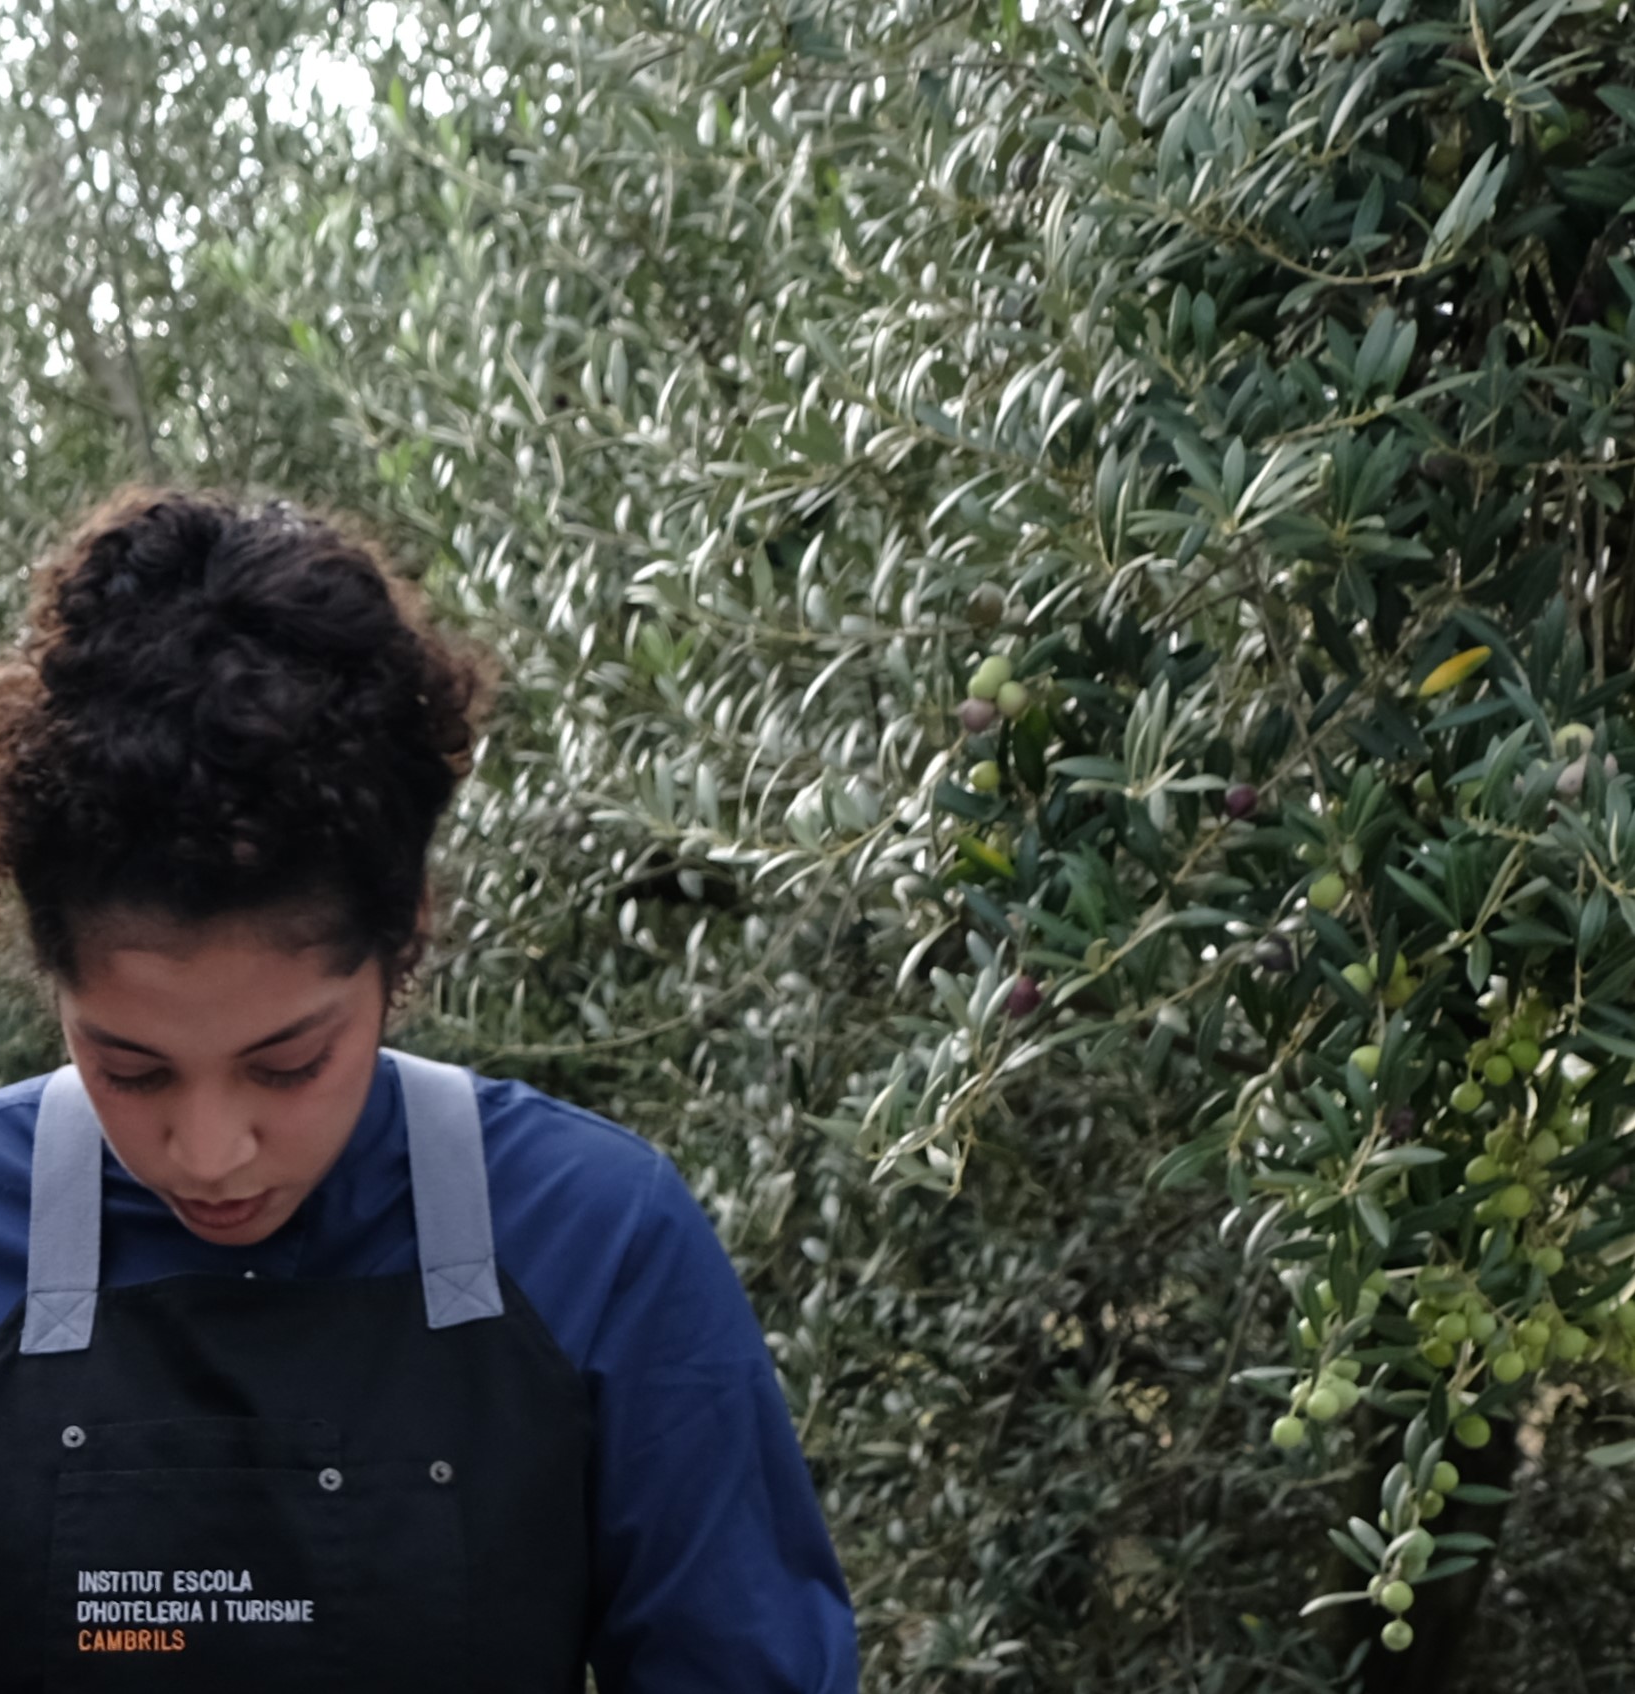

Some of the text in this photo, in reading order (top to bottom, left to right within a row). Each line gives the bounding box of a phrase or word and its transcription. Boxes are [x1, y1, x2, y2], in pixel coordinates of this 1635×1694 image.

[78, 1570, 252, 1594] INSTITUT ESCOLA
[77, 1600, 314, 1623] D'HOTELERIA I TURISME
[78, 1629, 186, 1651] CAMBRILS
